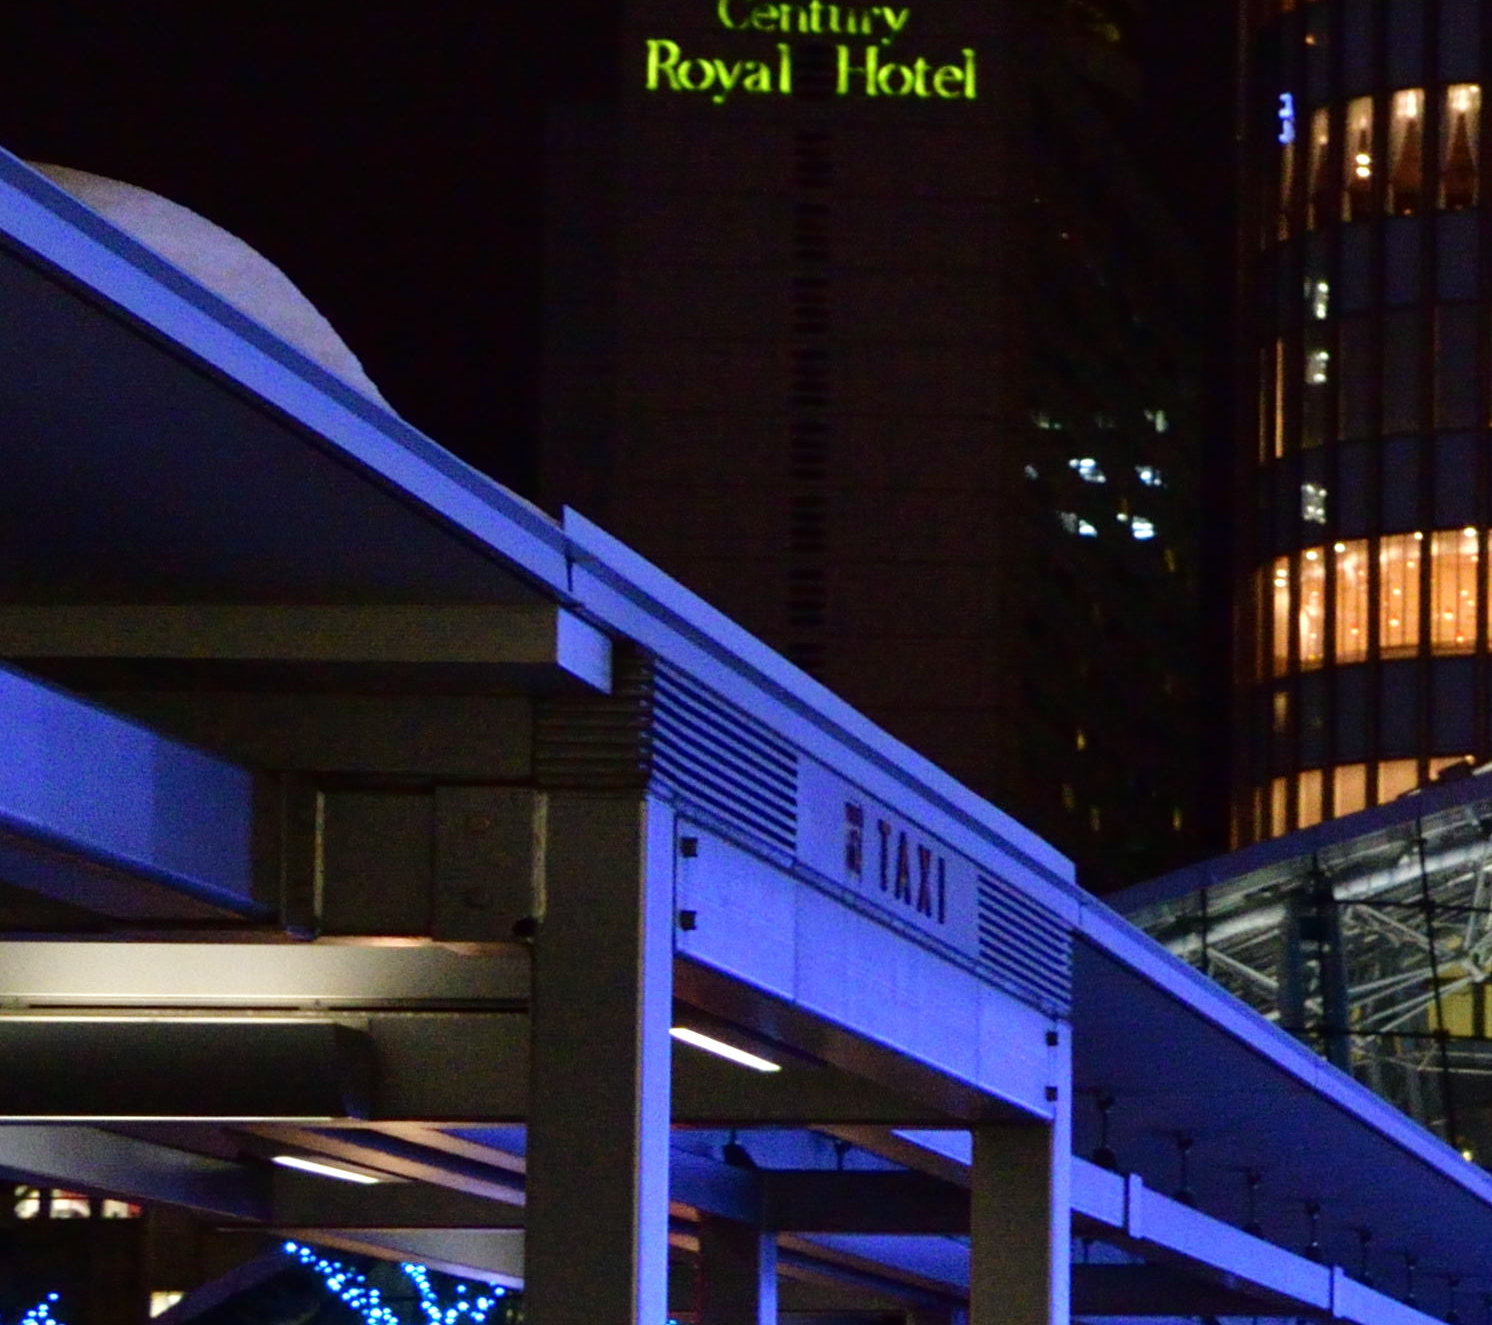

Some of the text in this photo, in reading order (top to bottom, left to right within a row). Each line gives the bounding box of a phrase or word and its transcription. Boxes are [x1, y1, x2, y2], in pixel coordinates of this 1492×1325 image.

[646, 39, 977, 104] Royal Hotel
[876, 818, 946, 925] TAXI
